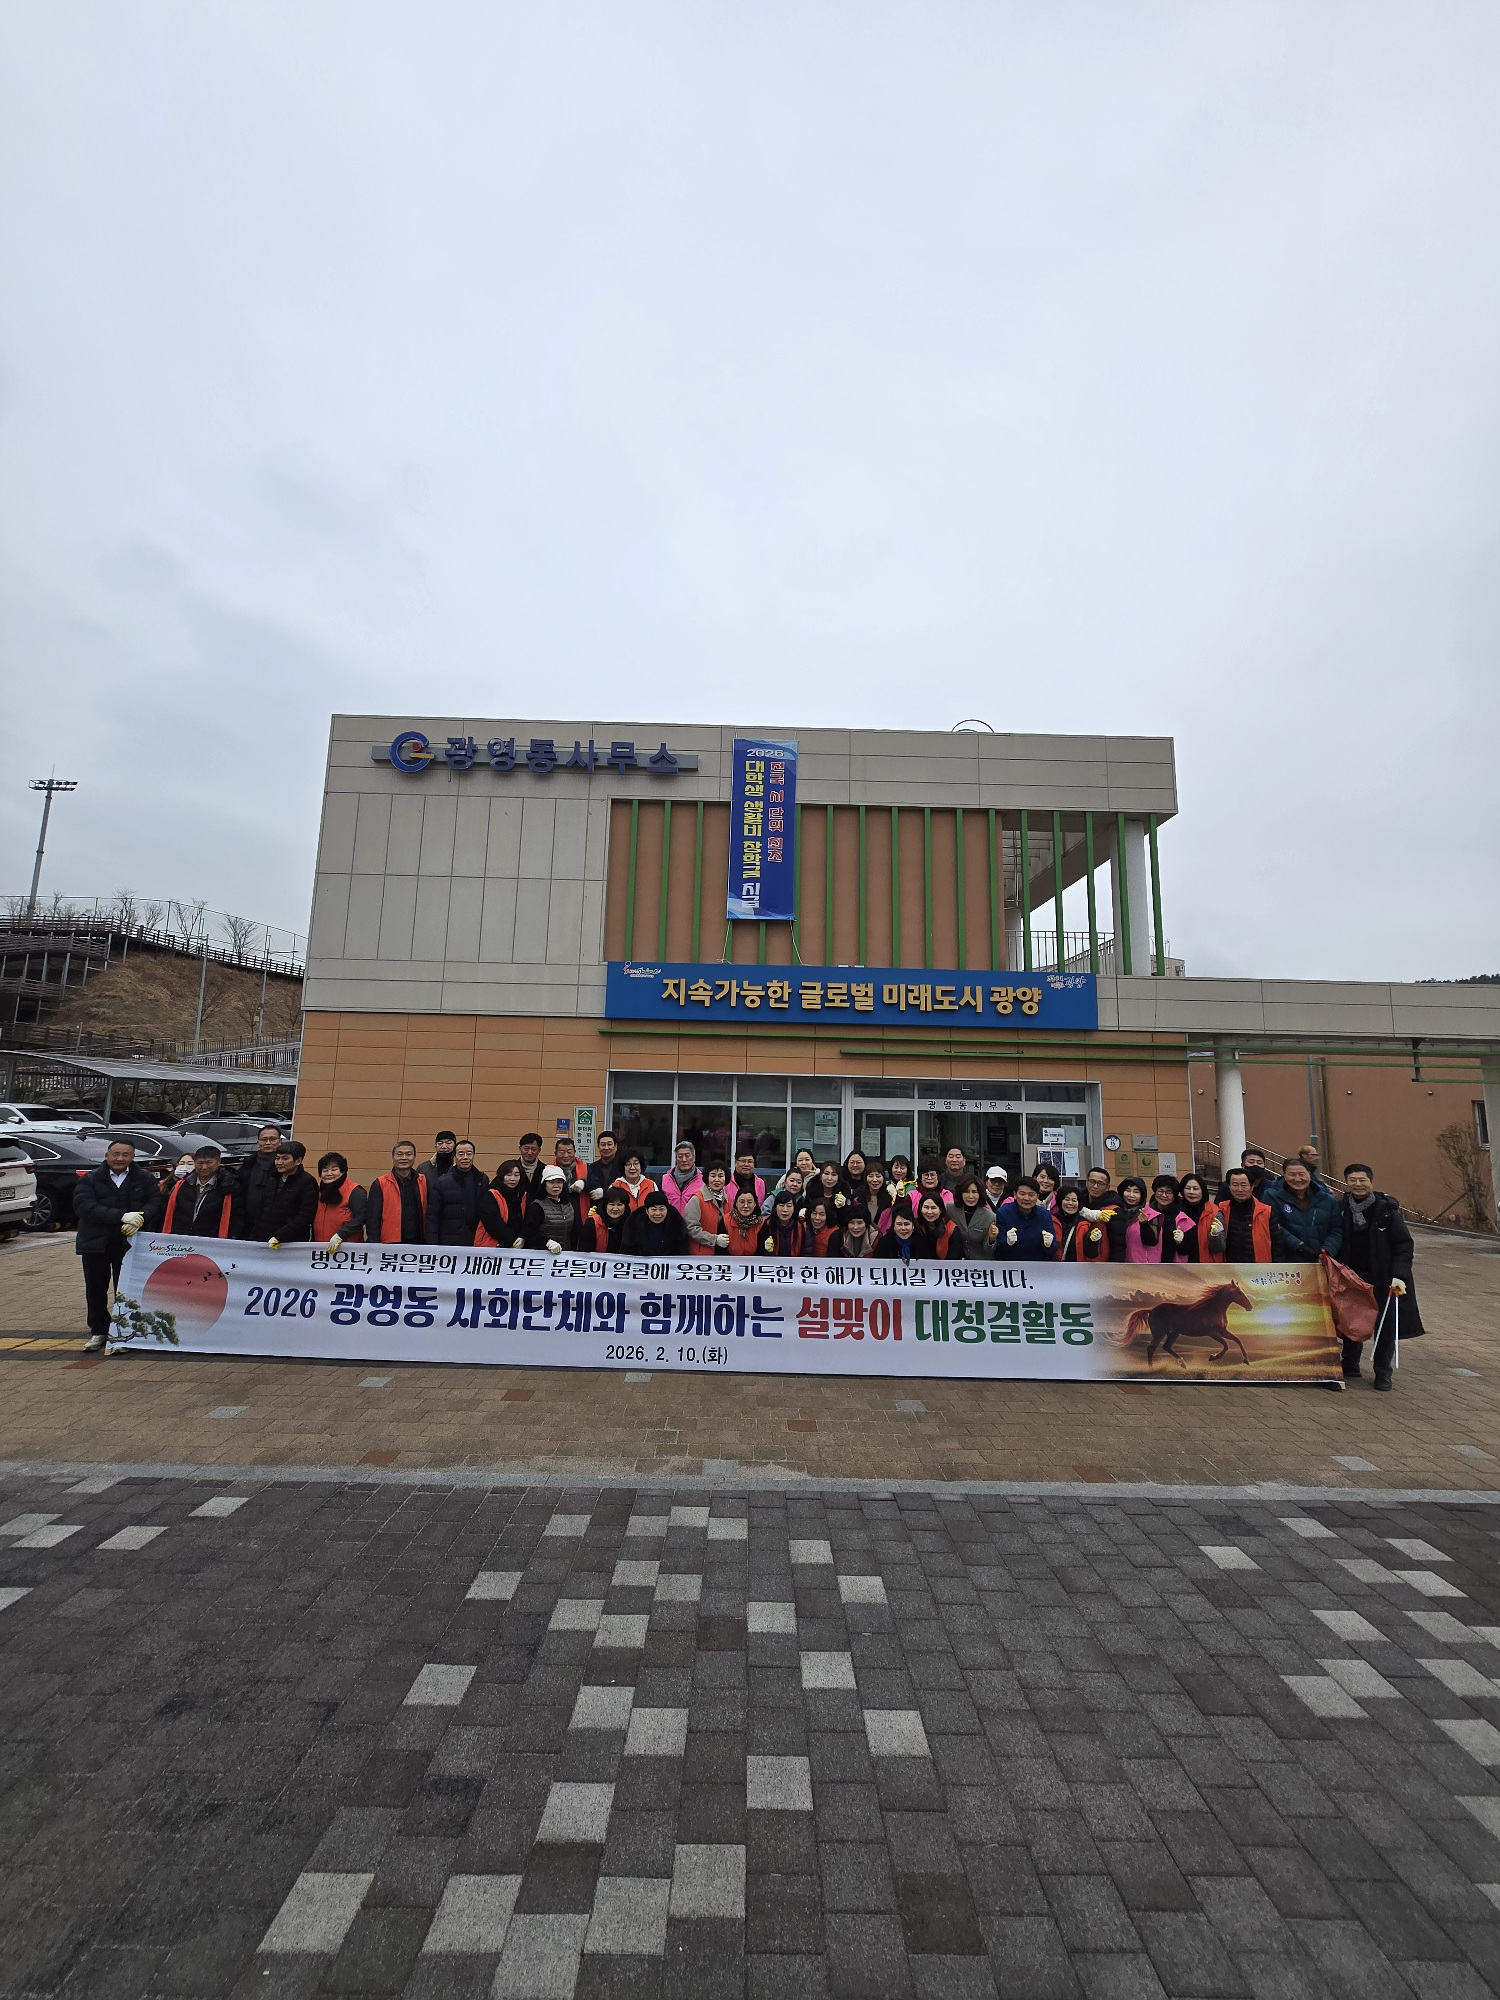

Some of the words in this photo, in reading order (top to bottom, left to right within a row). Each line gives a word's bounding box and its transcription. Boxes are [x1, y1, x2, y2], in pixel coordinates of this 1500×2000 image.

[445, 736, 679, 775] 광영동사무소
[746, 749, 785, 758] 2026
[745, 760, 765, 797] 대학생
[769, 789, 785, 803] 시
[743, 800, 764, 837] 생활비
[768, 806, 785, 833] 단위
[742, 840, 763, 879] 장학금
[741, 882, 761, 910] 지급
[661, 977, 792, 1009] 지속가능한
[798, 979, 875, 1012] 글로벌
[882, 982, 983, 1014] 미래도시
[989, 984, 1043, 1015] 광양
[927, 1100, 1014, 1111] 광영동사무소
[311, 1250, 373, 1275] 병오년,
[379, 1252, 457, 1275] 붉은말의
[460, 1255, 503, 1276] 새해
[506, 1257, 546, 1277] 모든
[550, 1259, 607, 1280] 분들의
[612, 1261, 670, 1281] 얼굴에
[675, 1263, 733, 1283] 웃음꽃
[738, 1265, 796, 1285] 가득한
[800, 1266, 821, 1286] 한
[825, 1267, 864, 1286] 해가
[869, 1267, 927, 1288] 되시길
[931, 1268, 1035, 1290] 기원합니다.
[243, 1286, 319, 1319] 2026
[329, 1283, 440, 1328] 광영동
[446, 1288, 631, 1335] 사회단체와
[639, 1291, 785, 1339] 함께하는
[795, 1296, 902, 1342] 설맞이
[914, 1299, 1095, 1346] 대청결활동
[606, 1344, 650, 1363] 2026.
[656, 1346, 670, 1363] 2.
[677, 1344, 728, 1365] 10.(화)
